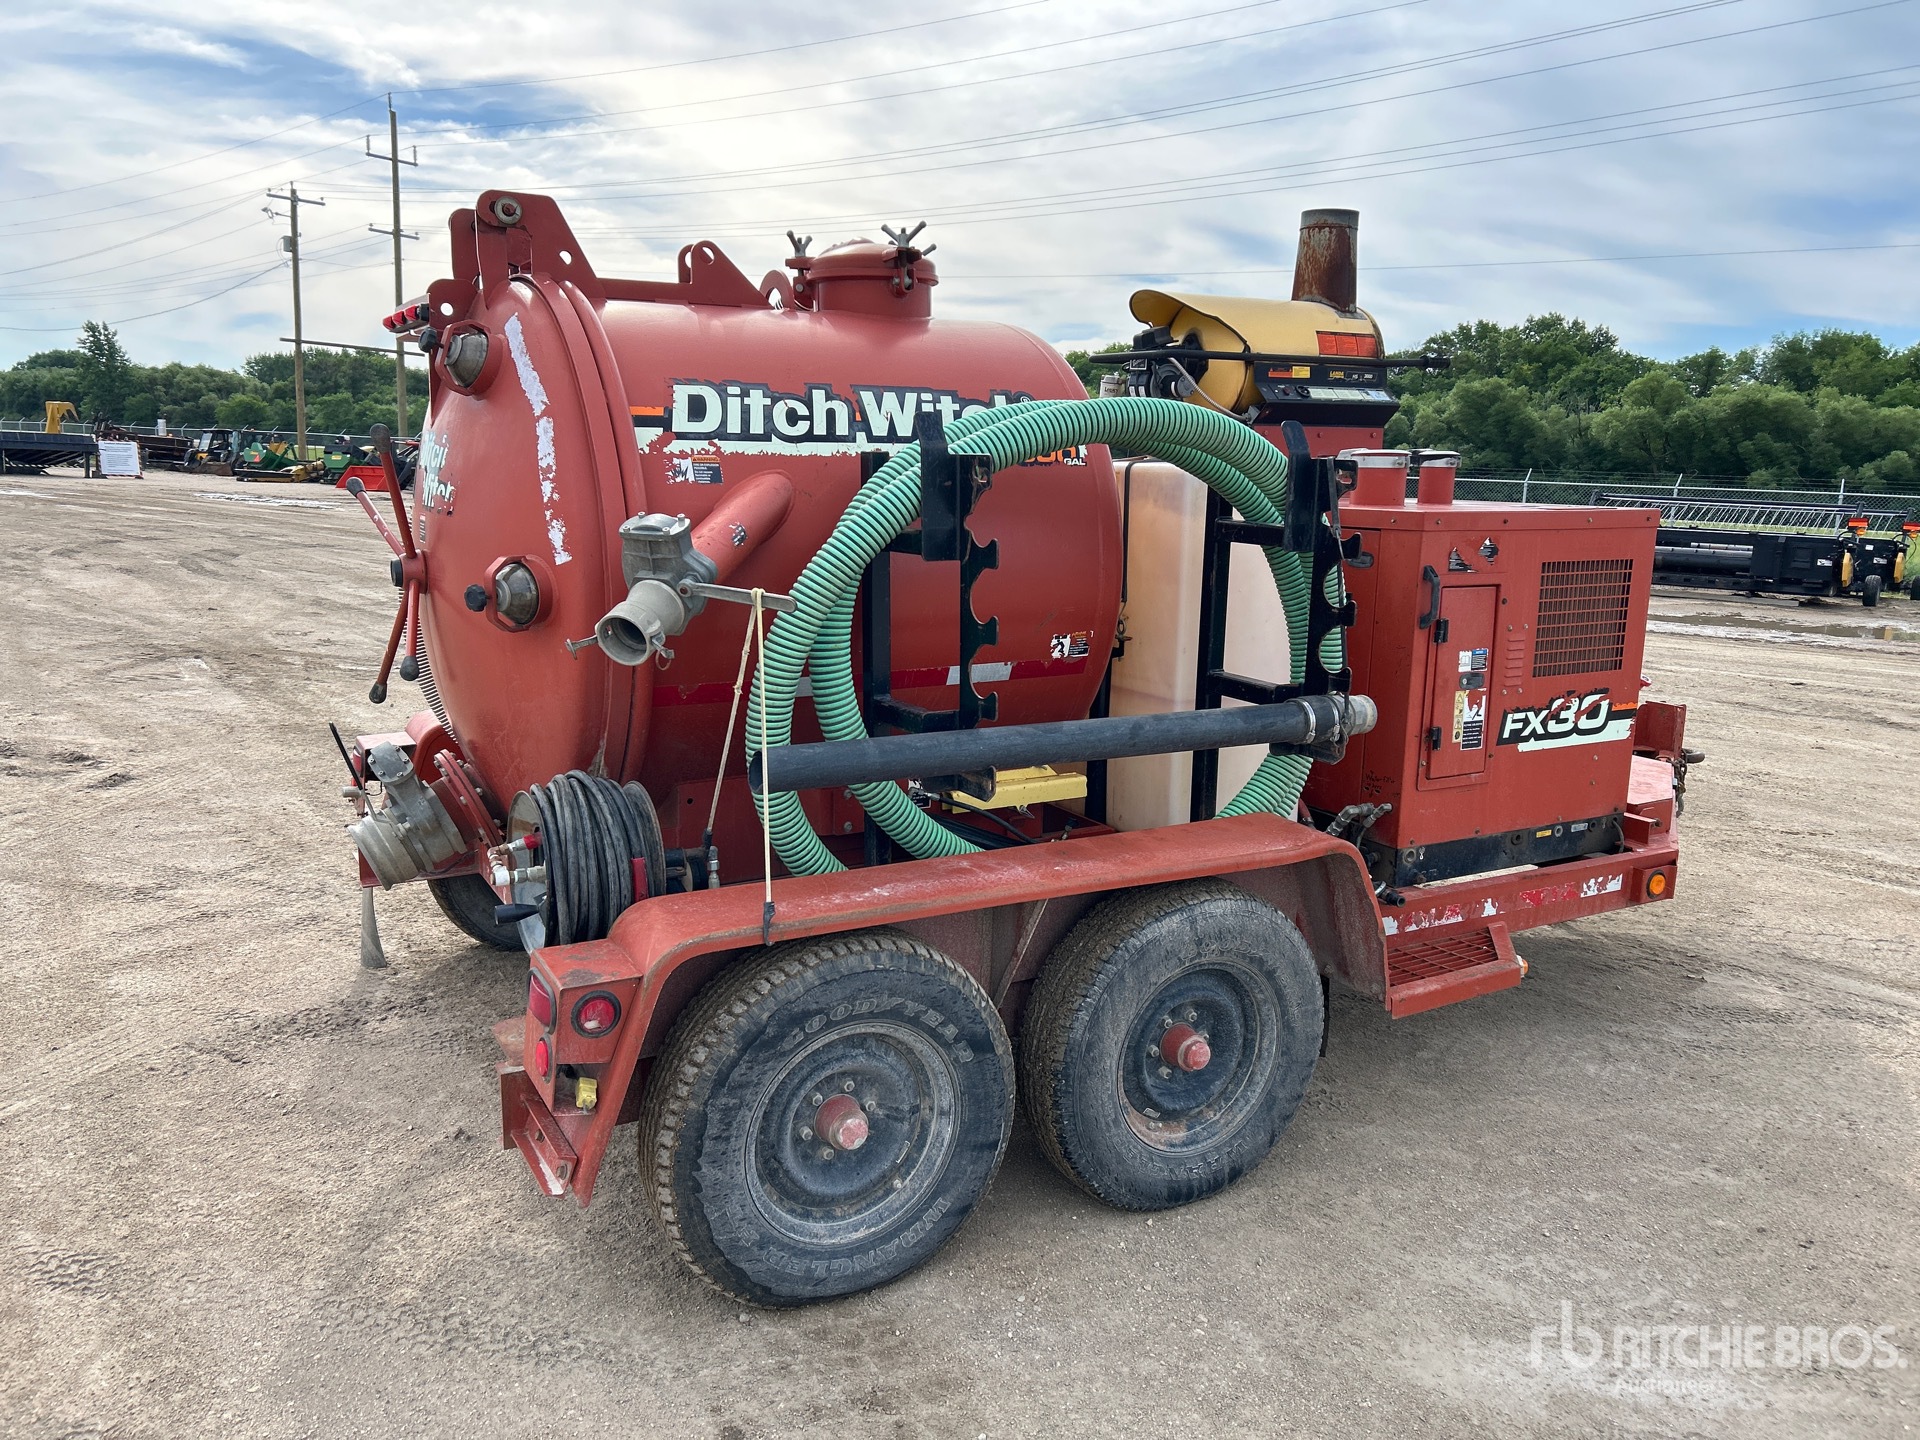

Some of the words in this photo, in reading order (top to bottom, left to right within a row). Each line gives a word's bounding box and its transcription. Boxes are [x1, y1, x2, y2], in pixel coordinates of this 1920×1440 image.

[672, 384, 849, 436] Ditch
[1064, 457, 1086, 466] GAL
[1503, 692, 1611, 738] FX30
[778, 997, 976, 1064] GOODYEAR
[761, 1196, 953, 1277] WRANGLER
